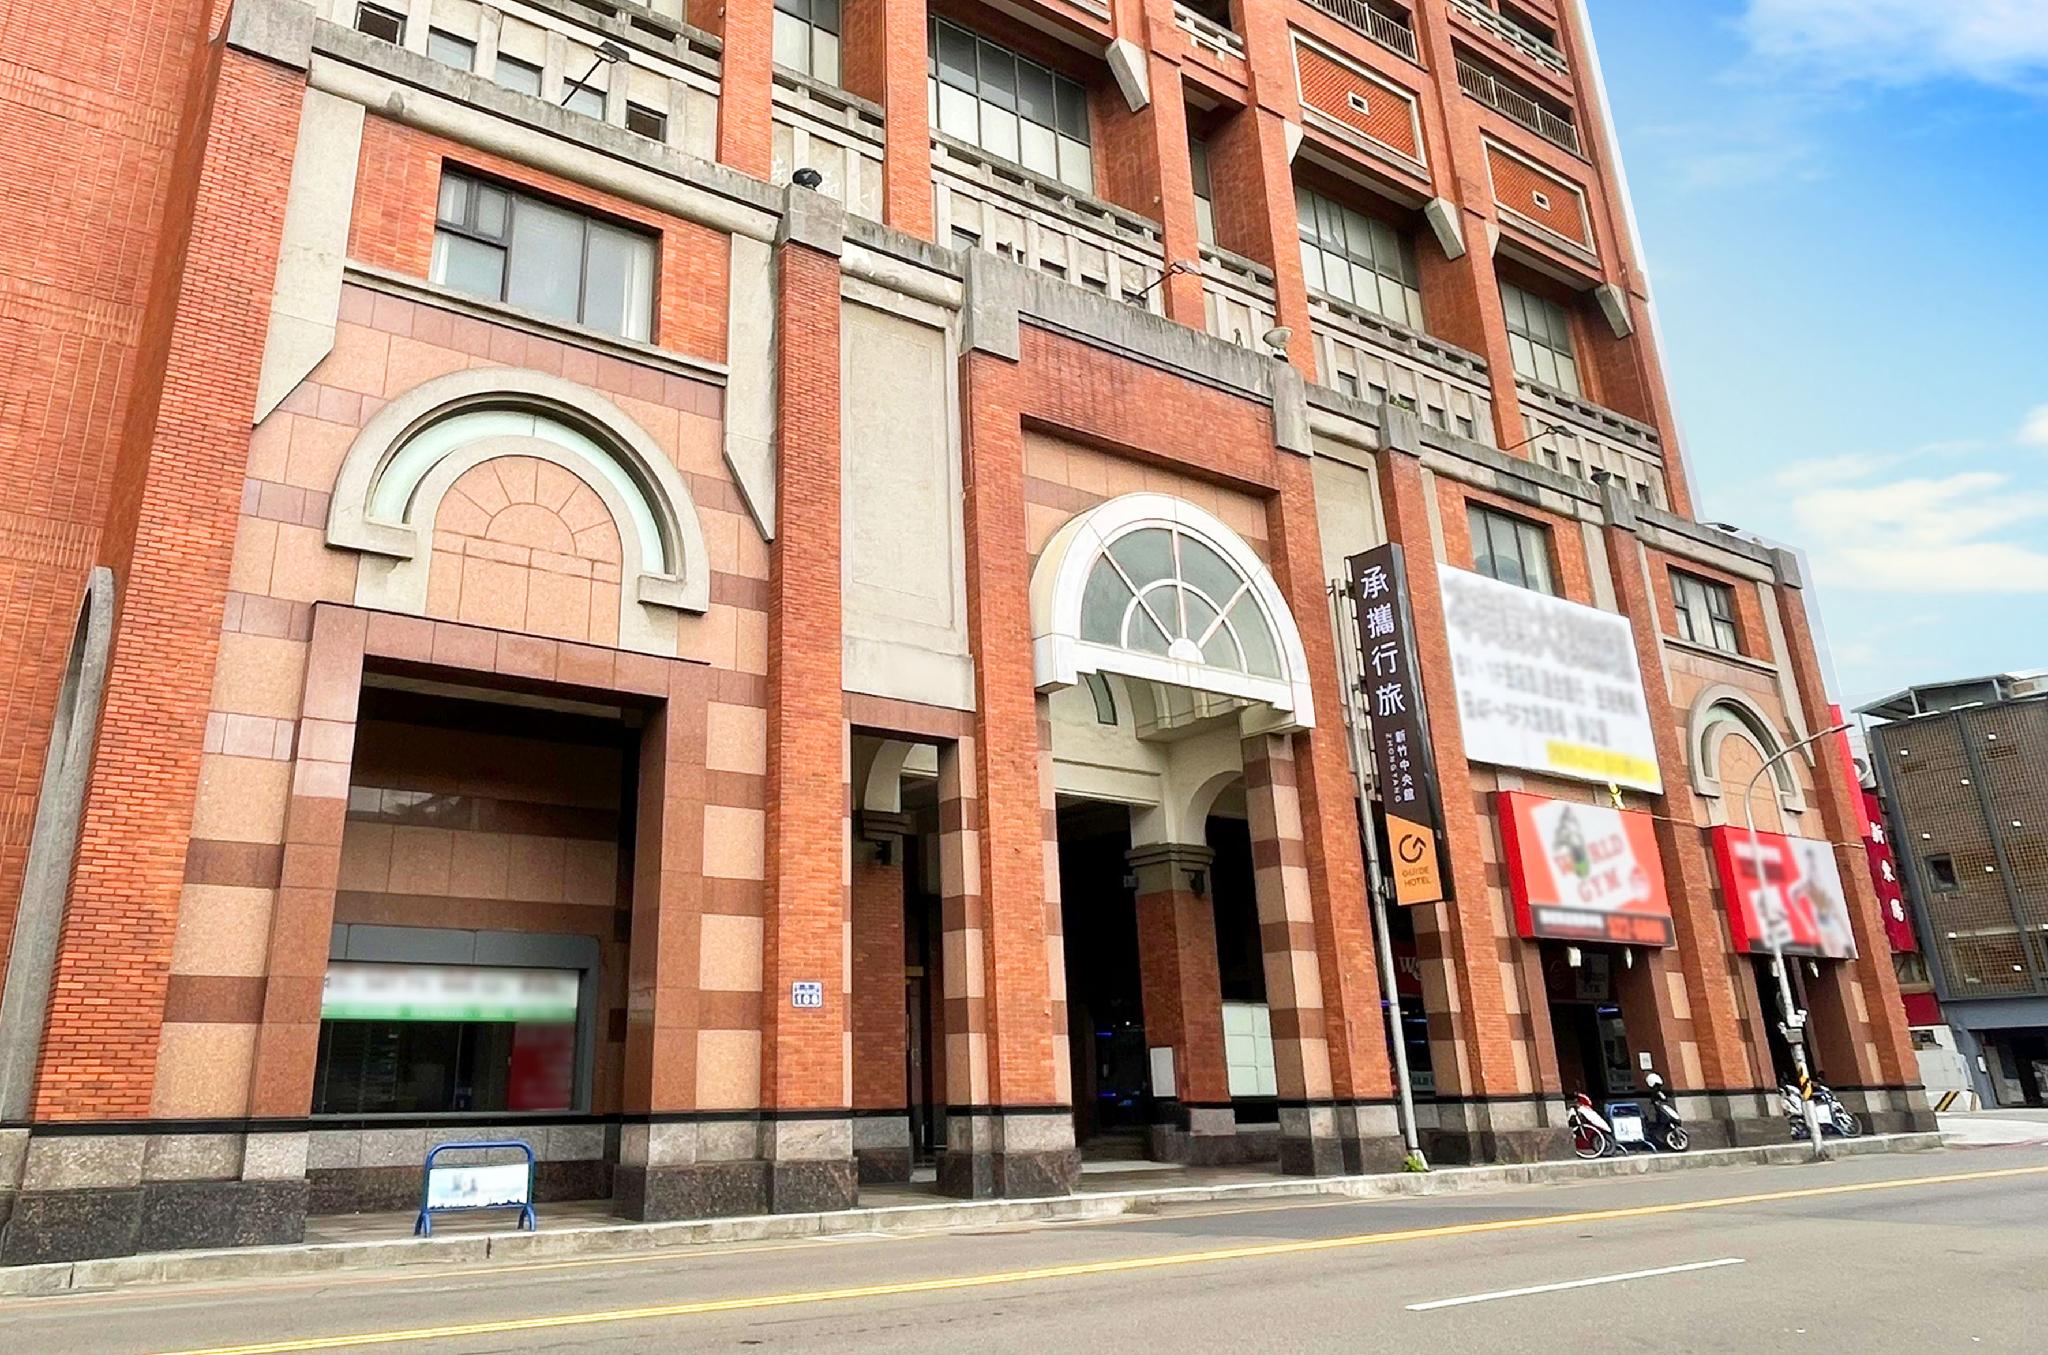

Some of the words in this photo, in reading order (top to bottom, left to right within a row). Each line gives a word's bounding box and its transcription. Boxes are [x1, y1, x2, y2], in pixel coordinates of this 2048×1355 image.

[1361, 565, 1406, 716] 承攜行旅
[1402, 866, 1428, 877] GUIDE
[1404, 876, 1431, 887] HOTEL
